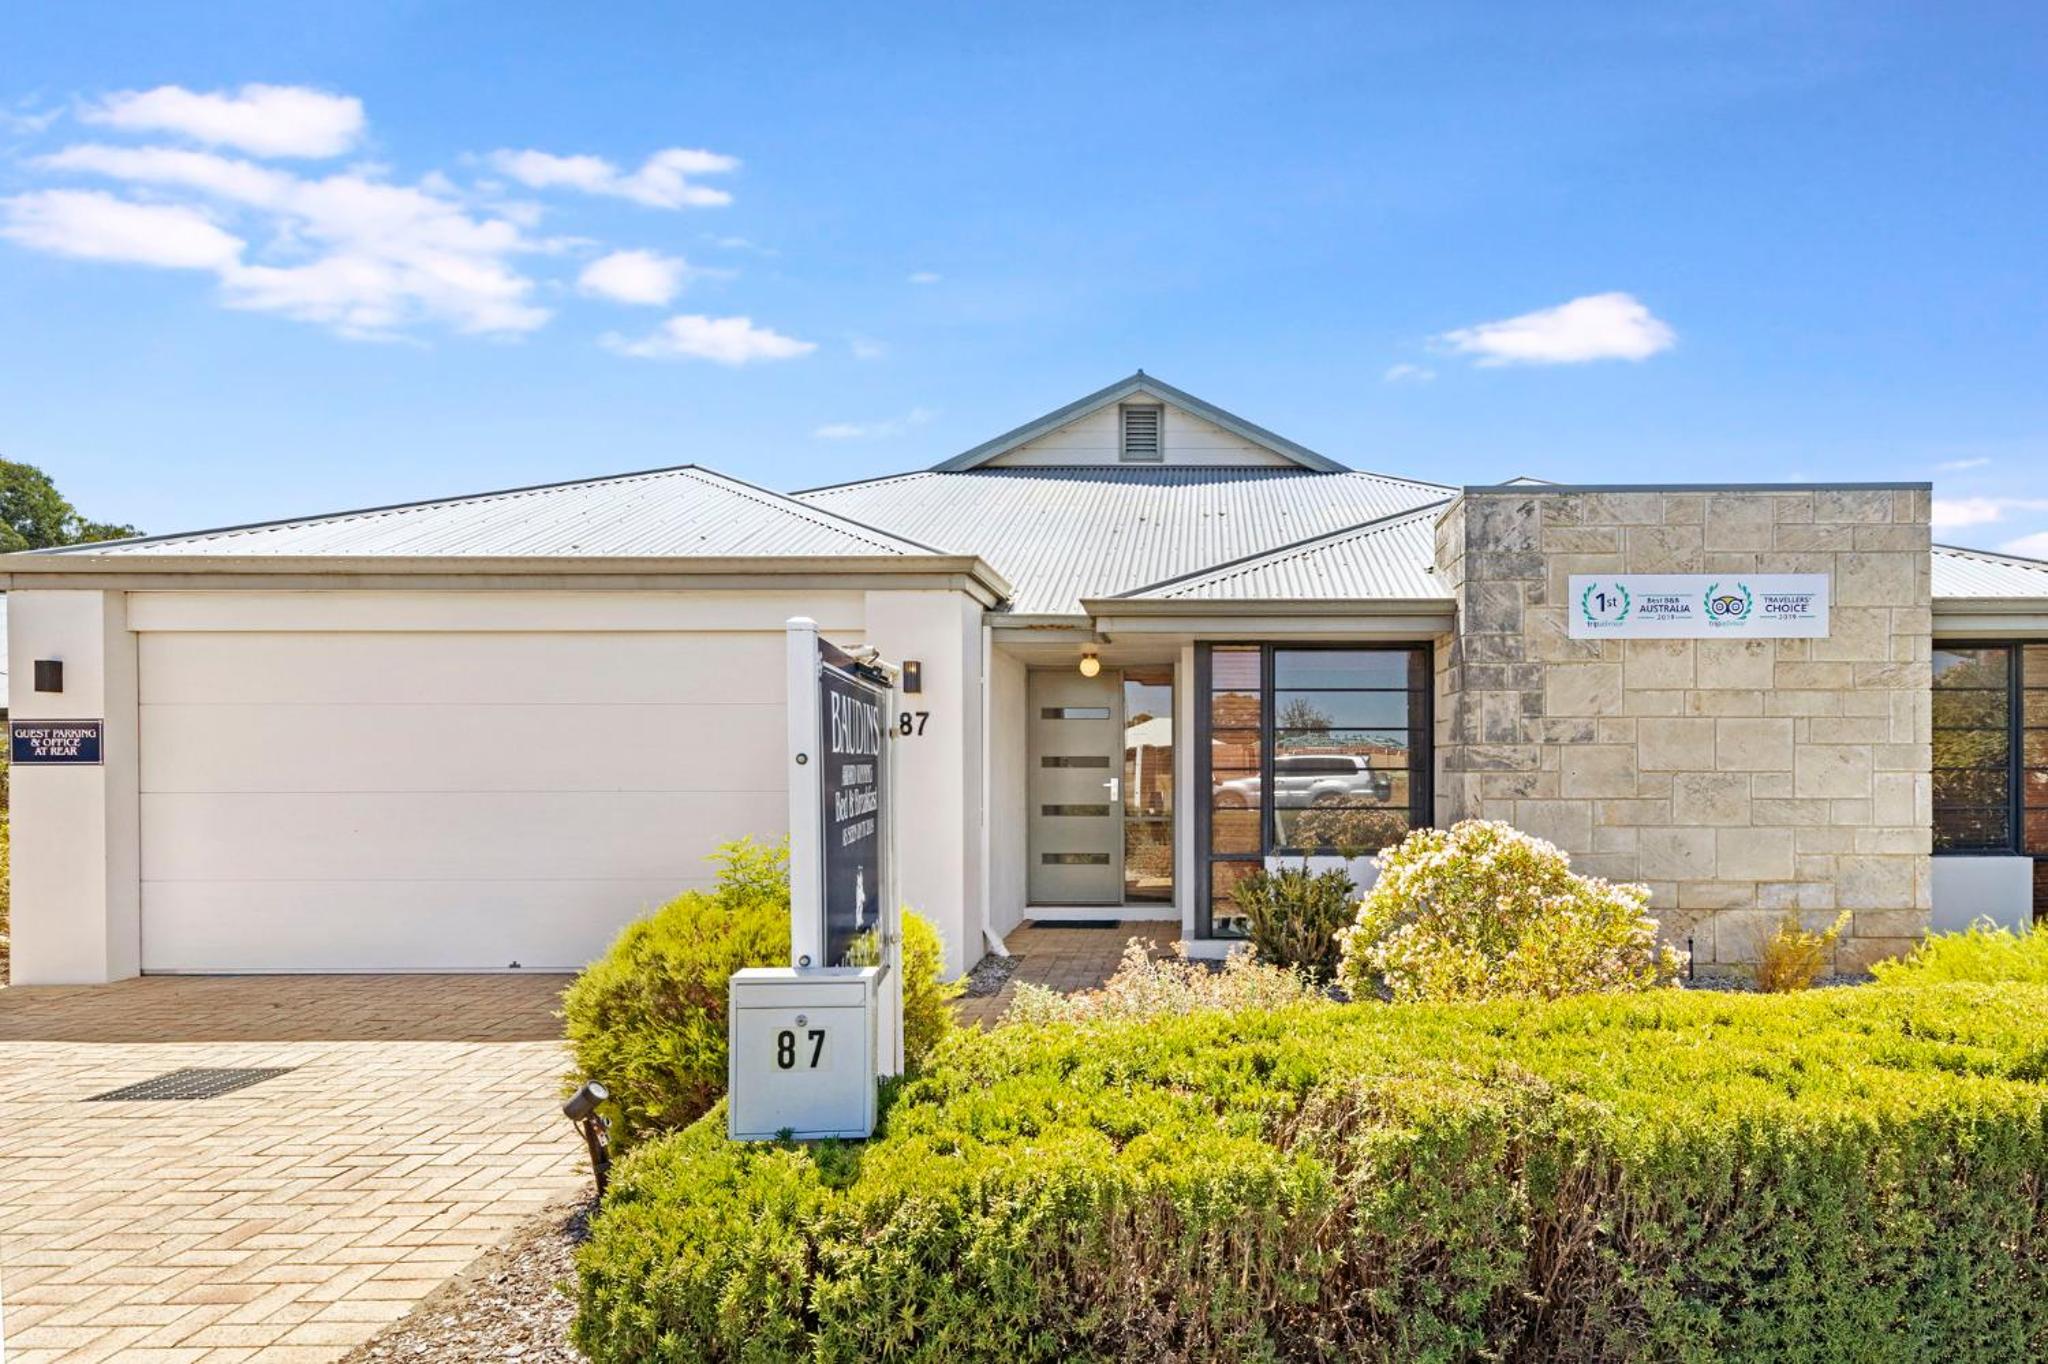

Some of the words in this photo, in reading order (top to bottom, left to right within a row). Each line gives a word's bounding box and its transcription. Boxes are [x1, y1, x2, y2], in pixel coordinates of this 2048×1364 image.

[1595, 593, 1617, 612] 1st
[1639, 604, 1691, 613] AUSTRALIA
[1765, 604, 1808, 613] CHOICE
[830, 690, 880, 755] BAUDINS
[899, 711, 930, 736] 87
[14, 728, 50, 738] GUEST
[52, 728, 97, 738] PARKING
[30, 738, 40, 747] &
[43, 738, 81, 747] OFFICE
[34, 747, 49, 756] AT
[50, 747, 78, 756] REAR
[777, 1029, 826, 1069] 87
